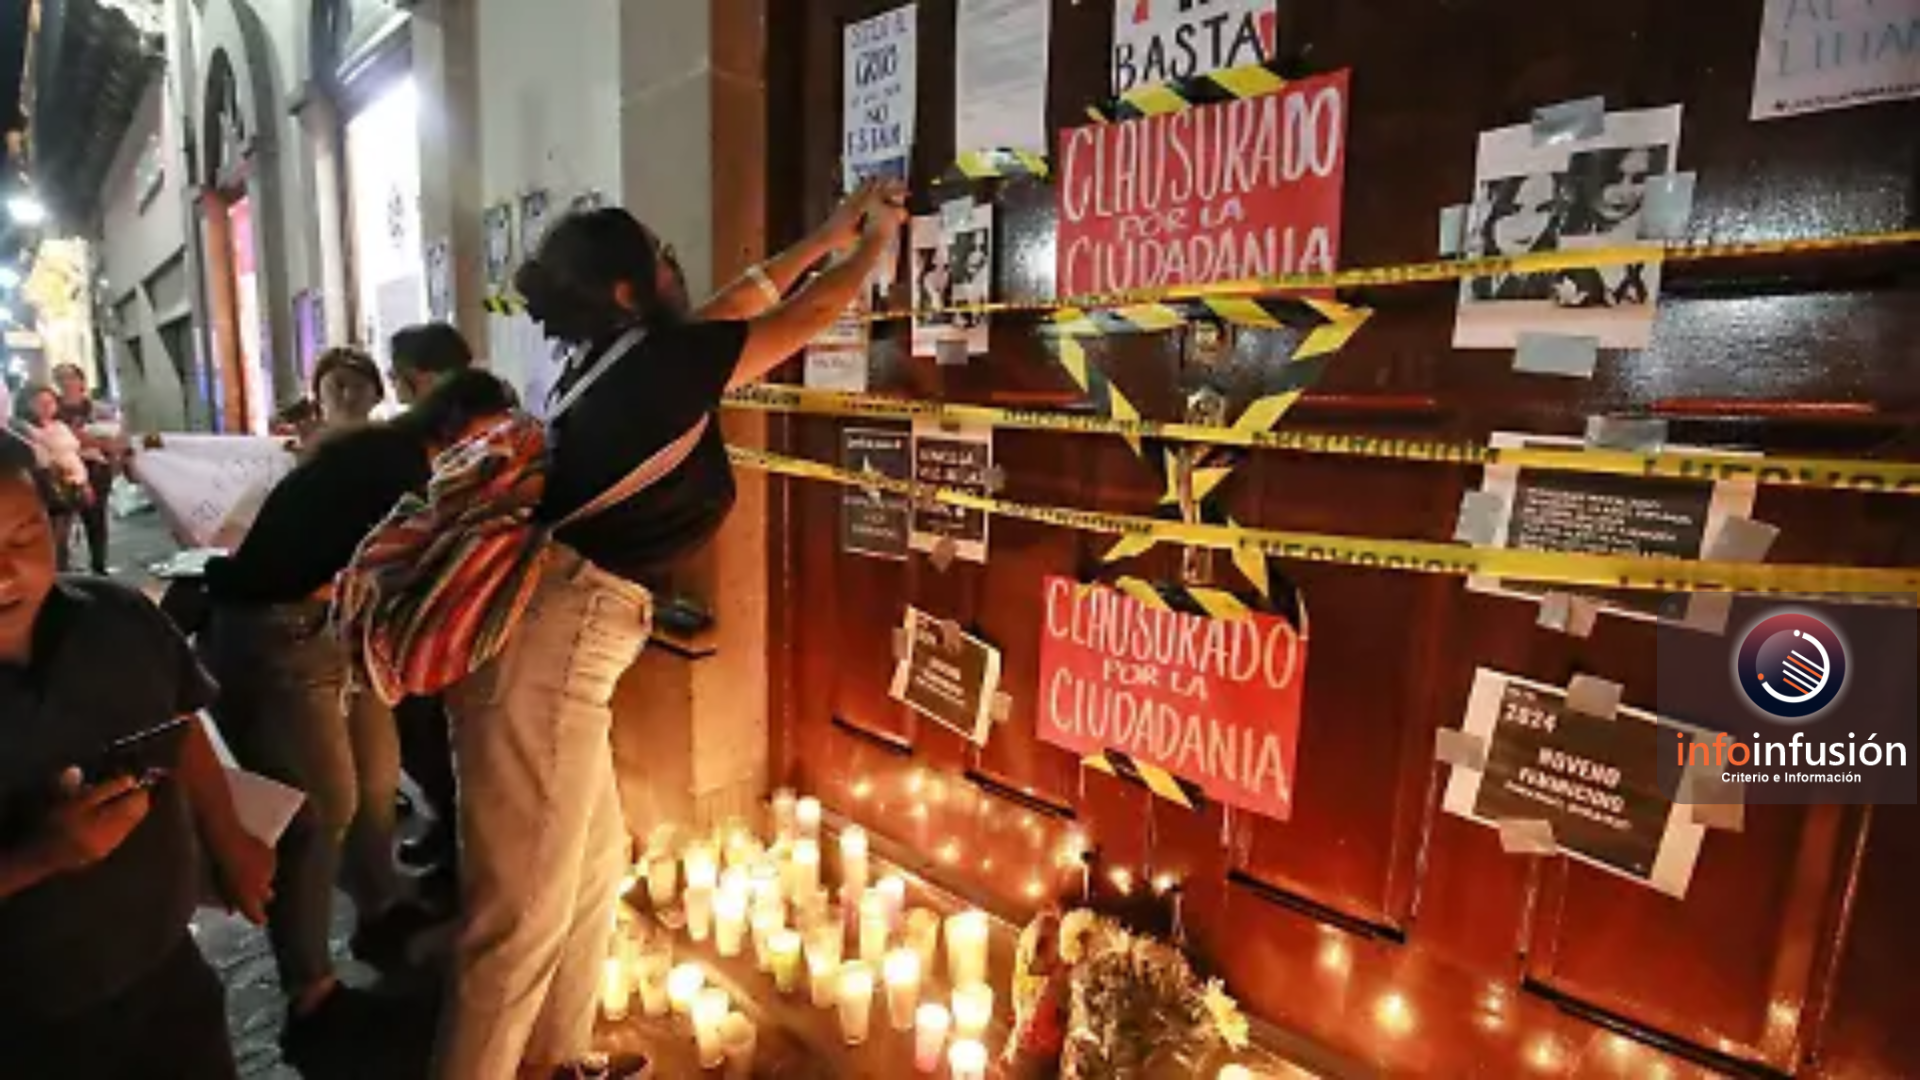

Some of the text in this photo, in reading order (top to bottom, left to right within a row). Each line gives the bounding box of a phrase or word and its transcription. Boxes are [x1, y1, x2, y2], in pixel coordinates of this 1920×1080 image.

[1063, 87, 1341, 221] CLAUSURADO
[1119, 197, 1245, 241] POR LA
[1047, 579, 1297, 689] CLAUSURADO
[1104, 659, 1208, 701] POR LA
[1050, 667, 1291, 804] CIUDADANIA
